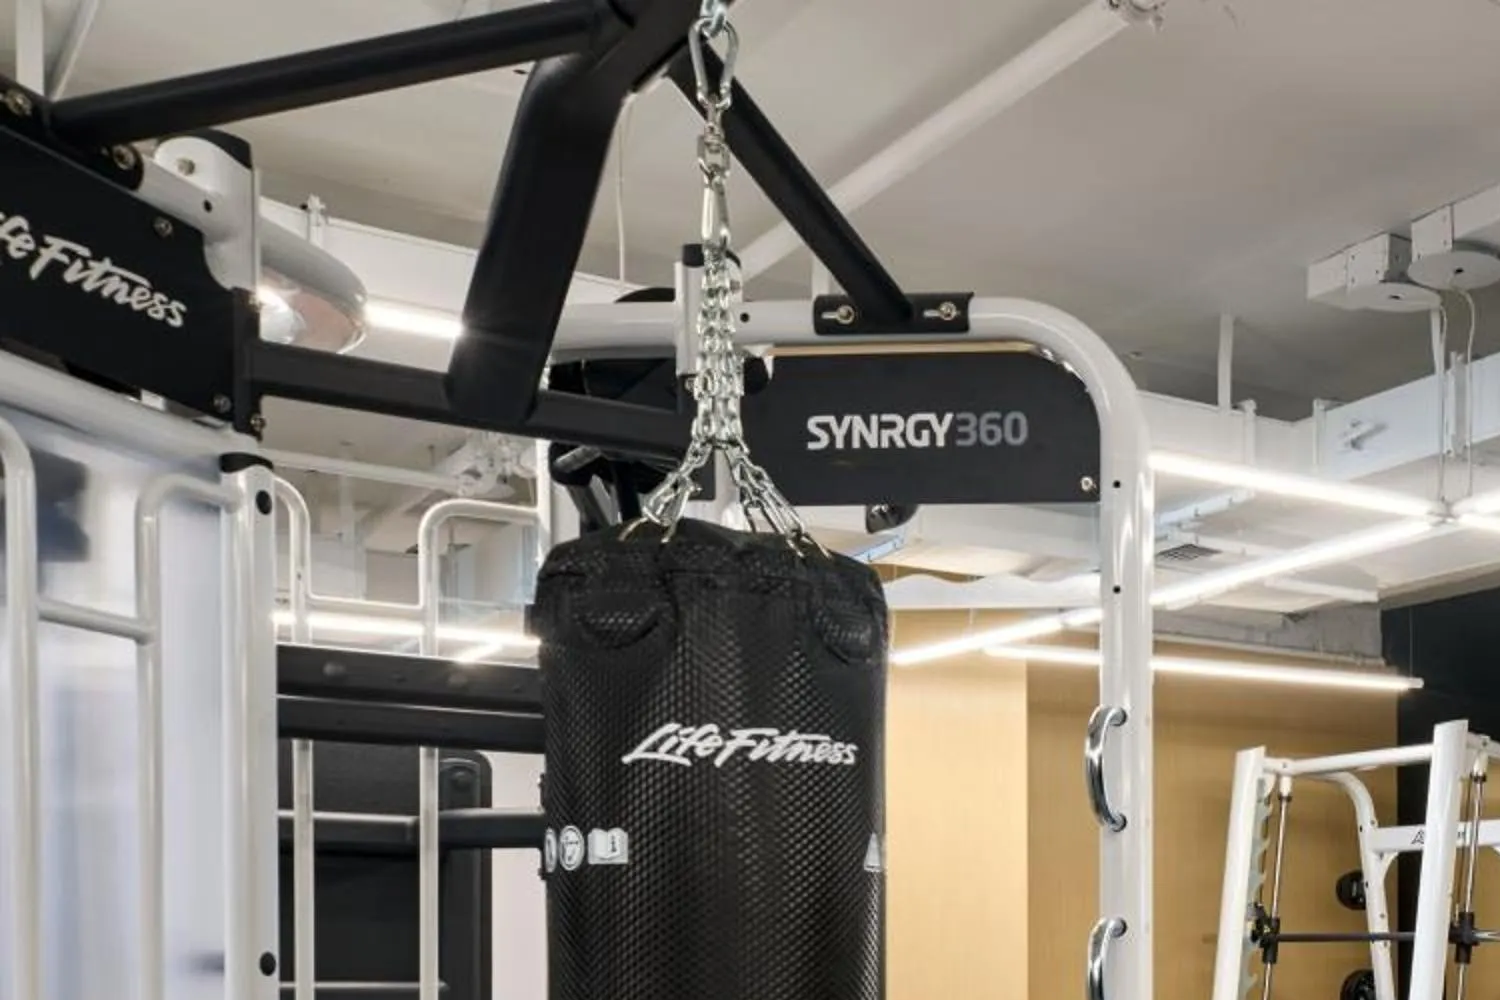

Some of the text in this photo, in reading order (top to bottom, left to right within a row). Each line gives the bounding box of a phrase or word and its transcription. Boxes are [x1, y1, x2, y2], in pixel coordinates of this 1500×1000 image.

[0, 212, 188, 328] fe Fitness
[807, 411, 1028, 450] SYNRGY360
[621, 722, 859, 768] Life Fitness
